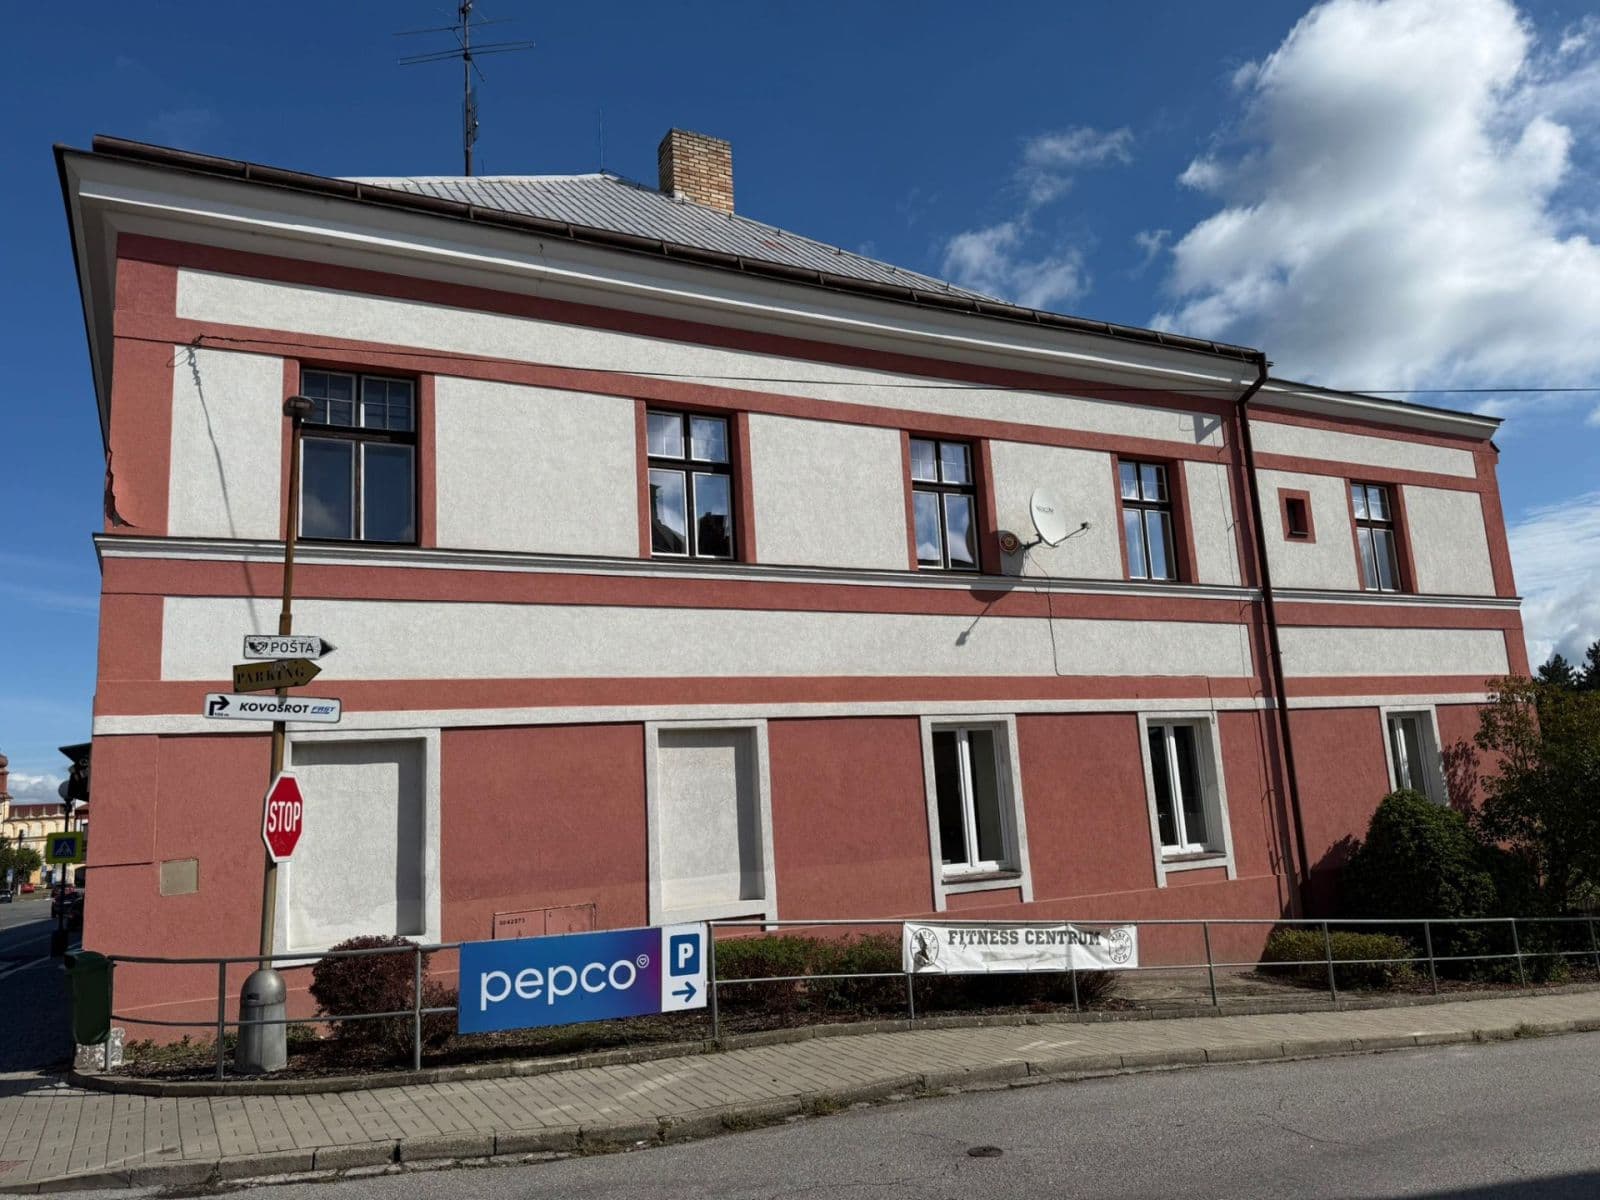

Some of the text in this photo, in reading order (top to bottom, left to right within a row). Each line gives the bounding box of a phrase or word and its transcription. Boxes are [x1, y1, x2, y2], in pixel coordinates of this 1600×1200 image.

[270, 640, 314, 653] POŠTA
[236, 663, 305, 684] PARKING
[268, 801, 300, 832] STOP
[948, 930, 1019, 945] FITNESS
[1025, 930, 1101, 945] CENTRUM
[678, 943, 694, 969] P
[480, 959, 637, 1011] pepco
